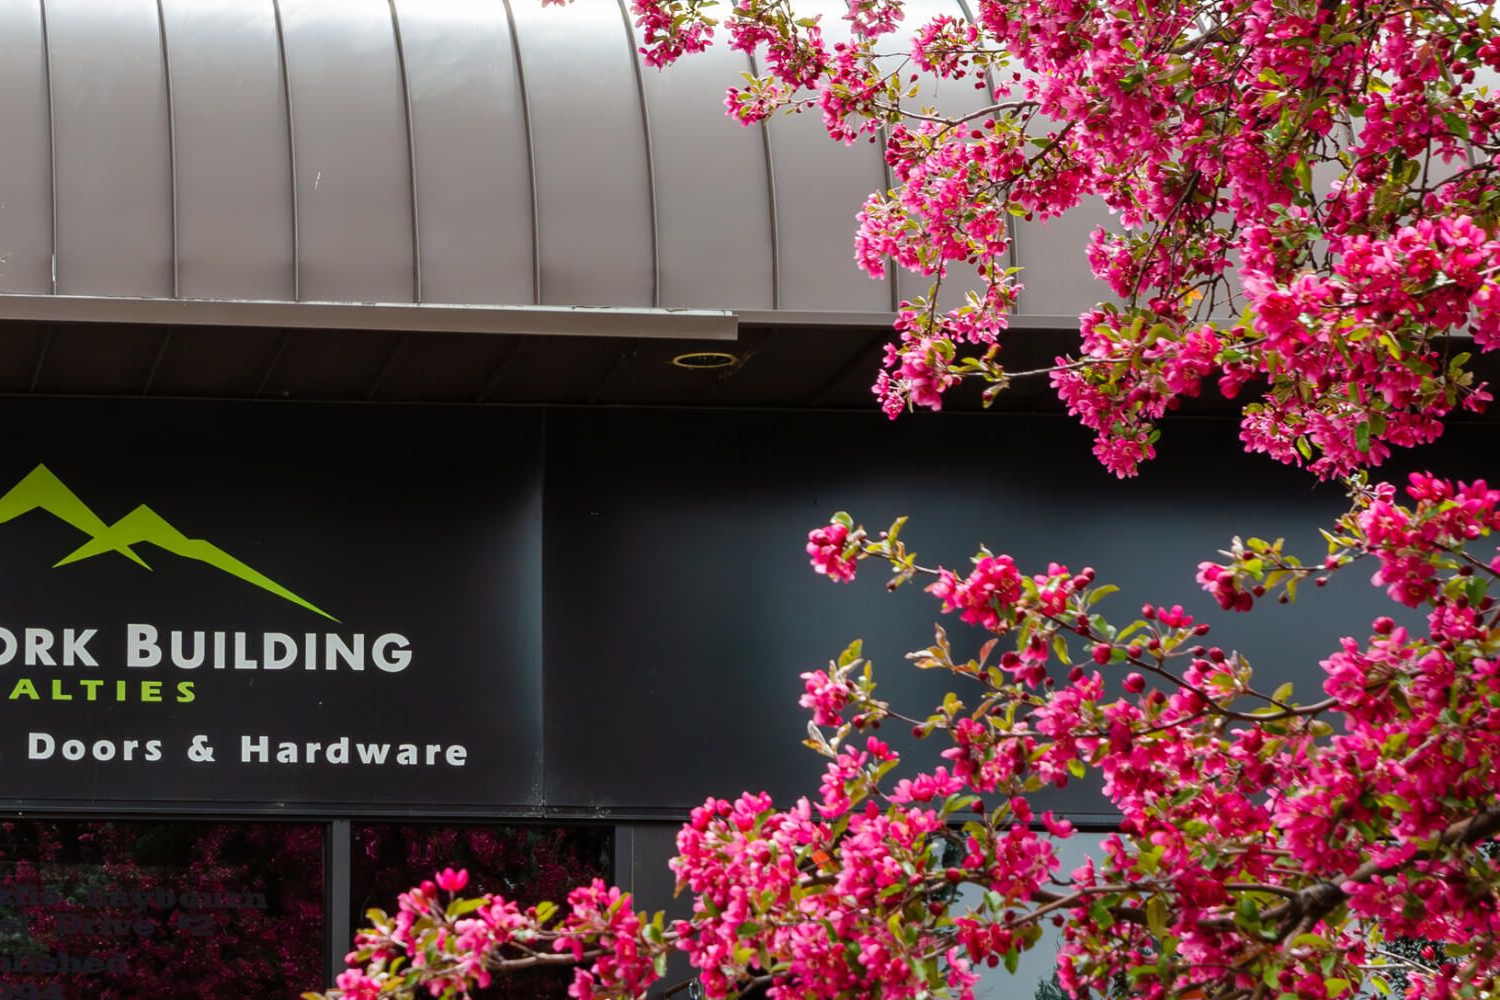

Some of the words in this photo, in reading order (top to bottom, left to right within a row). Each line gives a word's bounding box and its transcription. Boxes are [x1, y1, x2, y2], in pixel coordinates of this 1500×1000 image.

[126, 623, 413, 673] BUILDING
[28, 732, 162, 762] Doors
[187, 734, 216, 762] &
[241, 735, 468, 767] Hardware
[54, 913, 157, 936] Drive
